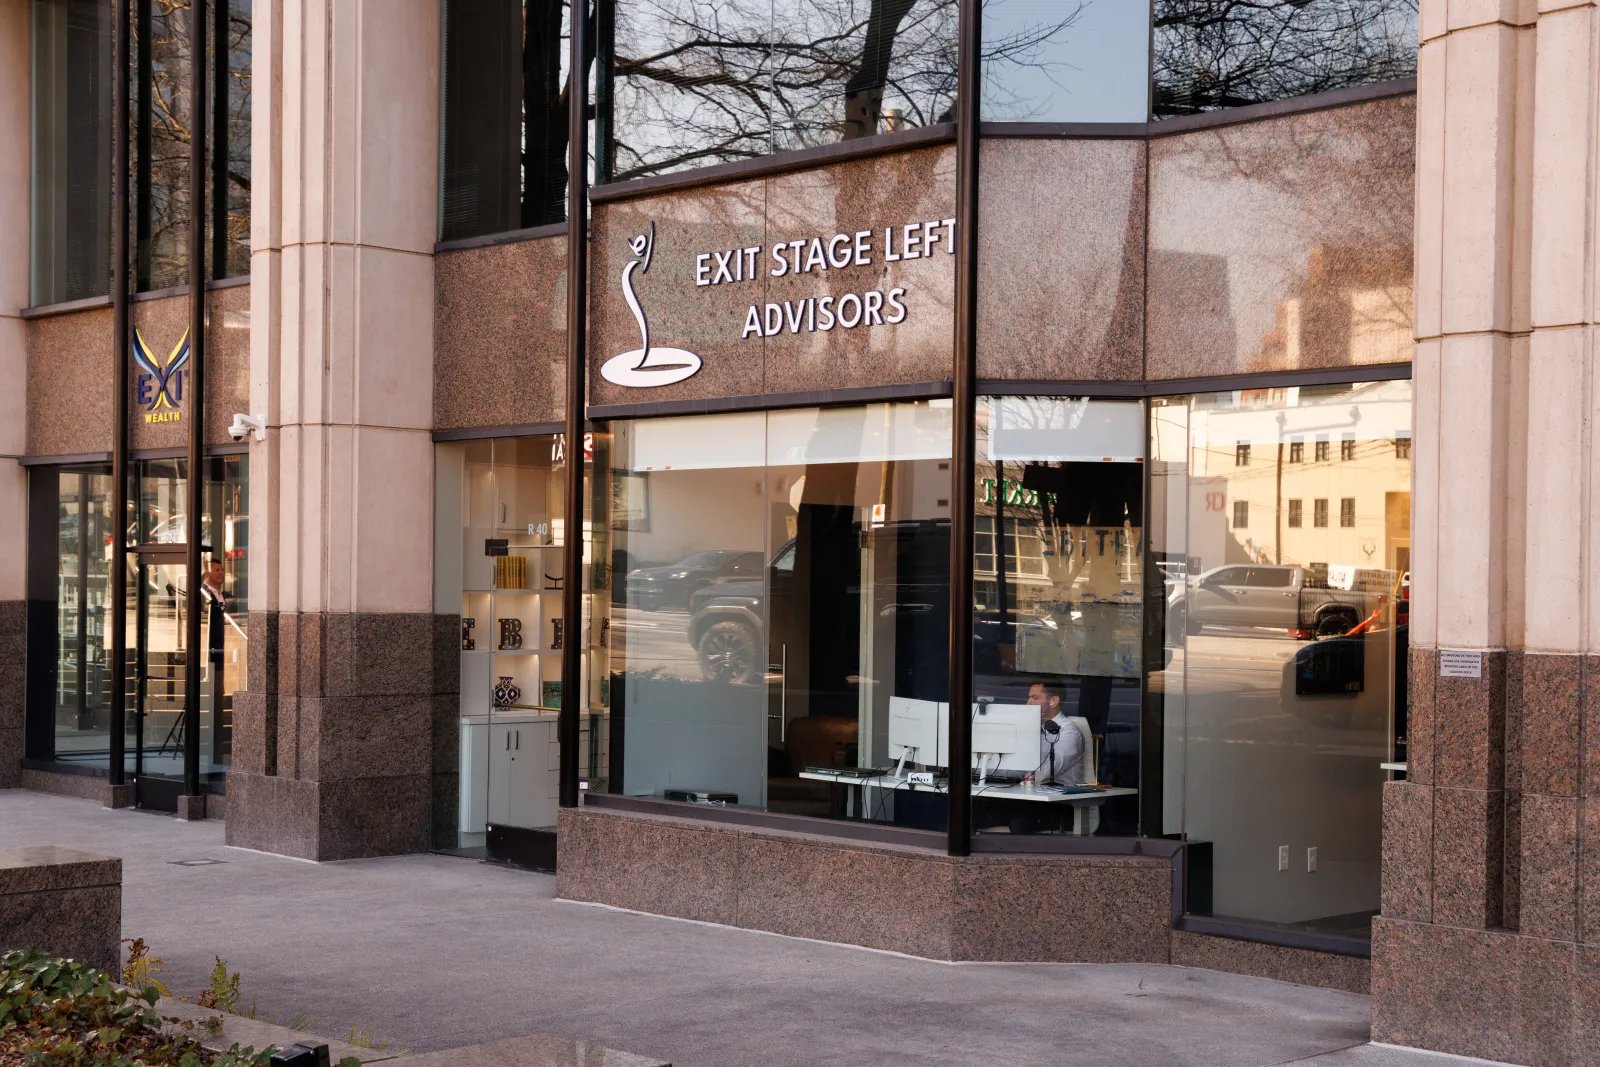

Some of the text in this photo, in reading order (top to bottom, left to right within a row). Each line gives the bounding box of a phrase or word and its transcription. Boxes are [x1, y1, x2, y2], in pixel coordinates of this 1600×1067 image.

[695, 218, 956, 287] EXIT STAGE LEFT
[741, 287, 907, 339] ADVISORS
[145, 411, 181, 424] WEALTH
[528, 523, 548, 536] R 40
